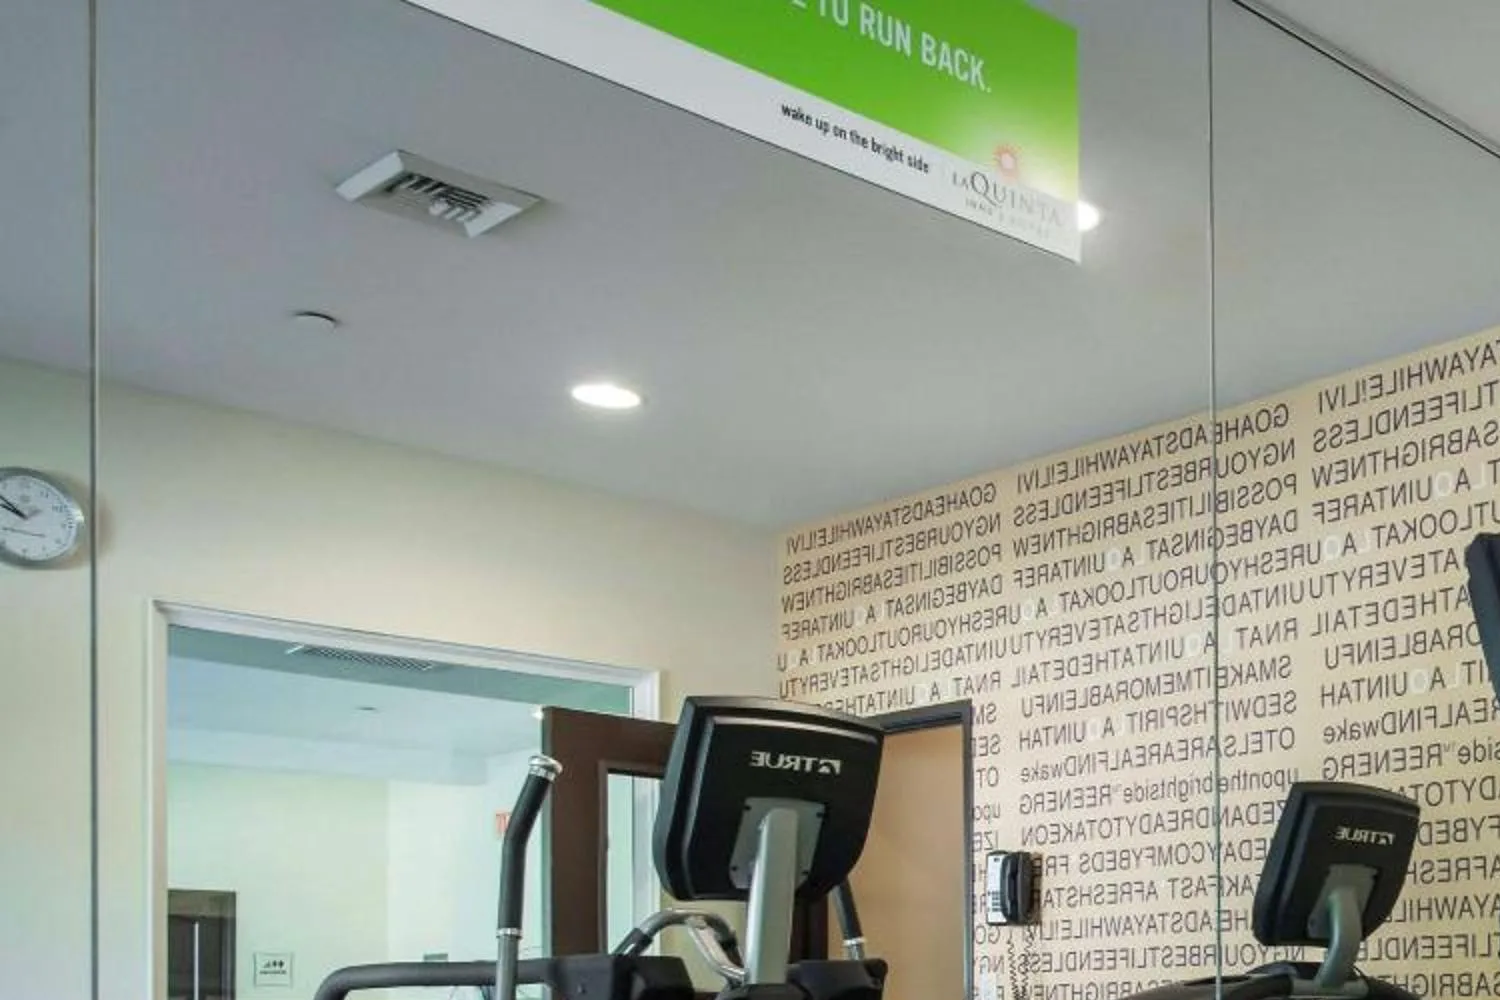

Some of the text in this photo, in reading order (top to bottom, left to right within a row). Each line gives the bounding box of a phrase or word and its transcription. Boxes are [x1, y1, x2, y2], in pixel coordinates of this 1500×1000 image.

[860, 4, 911, 56] RUN
[921, 32, 992, 93] BACK.
[781, 103, 812, 126] wake
[816, 117, 830, 136] up
[833, 125, 847, 140] on
[871, 137, 904, 163] bright
[908, 154, 929, 173] side
